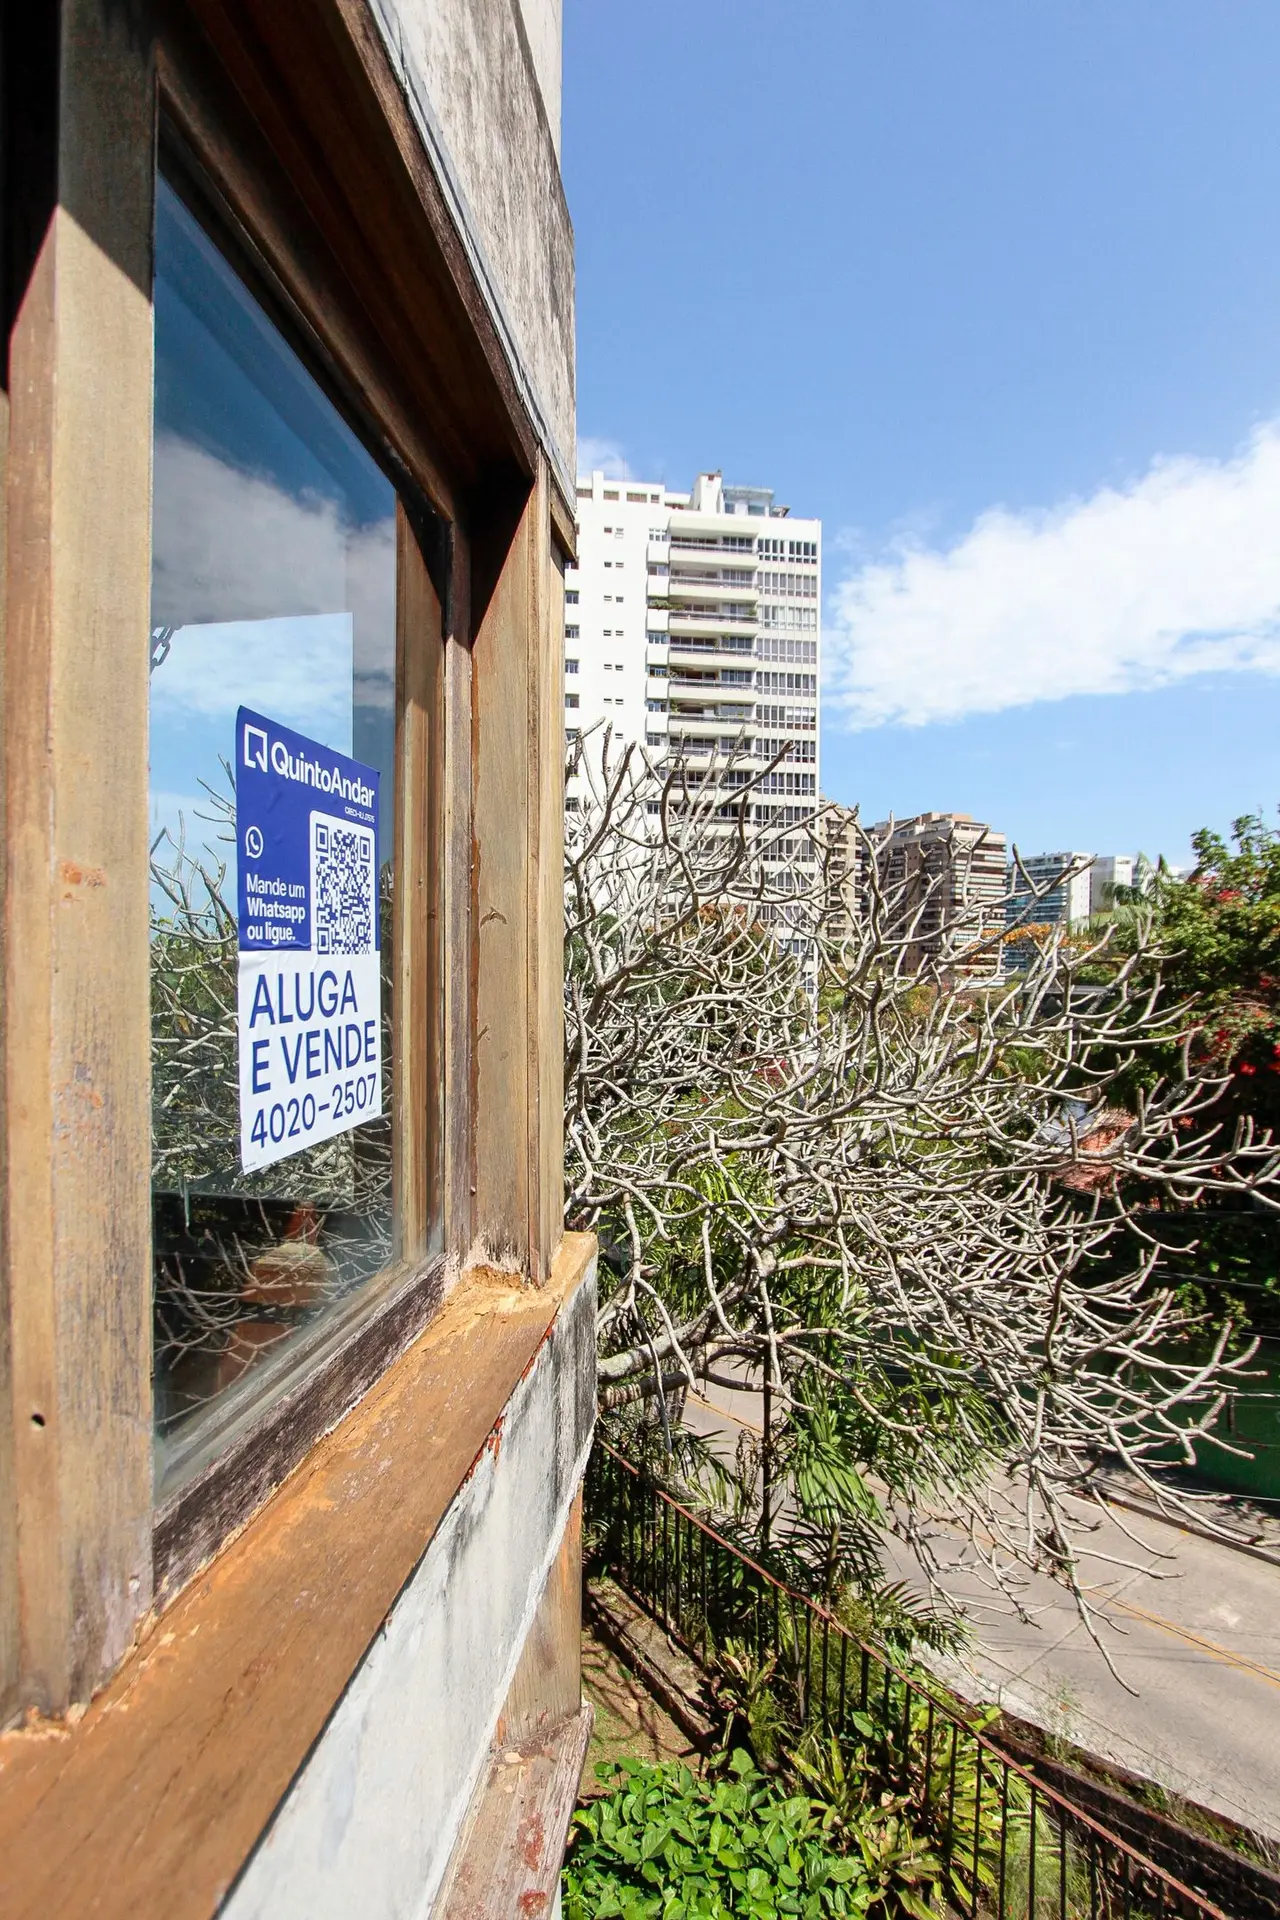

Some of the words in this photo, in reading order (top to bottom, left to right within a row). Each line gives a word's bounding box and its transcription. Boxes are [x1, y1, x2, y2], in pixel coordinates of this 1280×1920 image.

[271, 741, 375, 808] QuintoAndar
[246, 873, 287, 897] Mande
[288, 884, 306, 899] um
[246, 896, 306, 924] Whatsapp
[247, 924, 263, 940] ou
[265, 921, 296, 945] ligue.
[249, 970, 358, 1029] ALUGA
[252, 1039, 271, 1095] E
[281, 1019, 376, 1084] VENDE
[250, 1072, 377, 1149] 4020-2507
